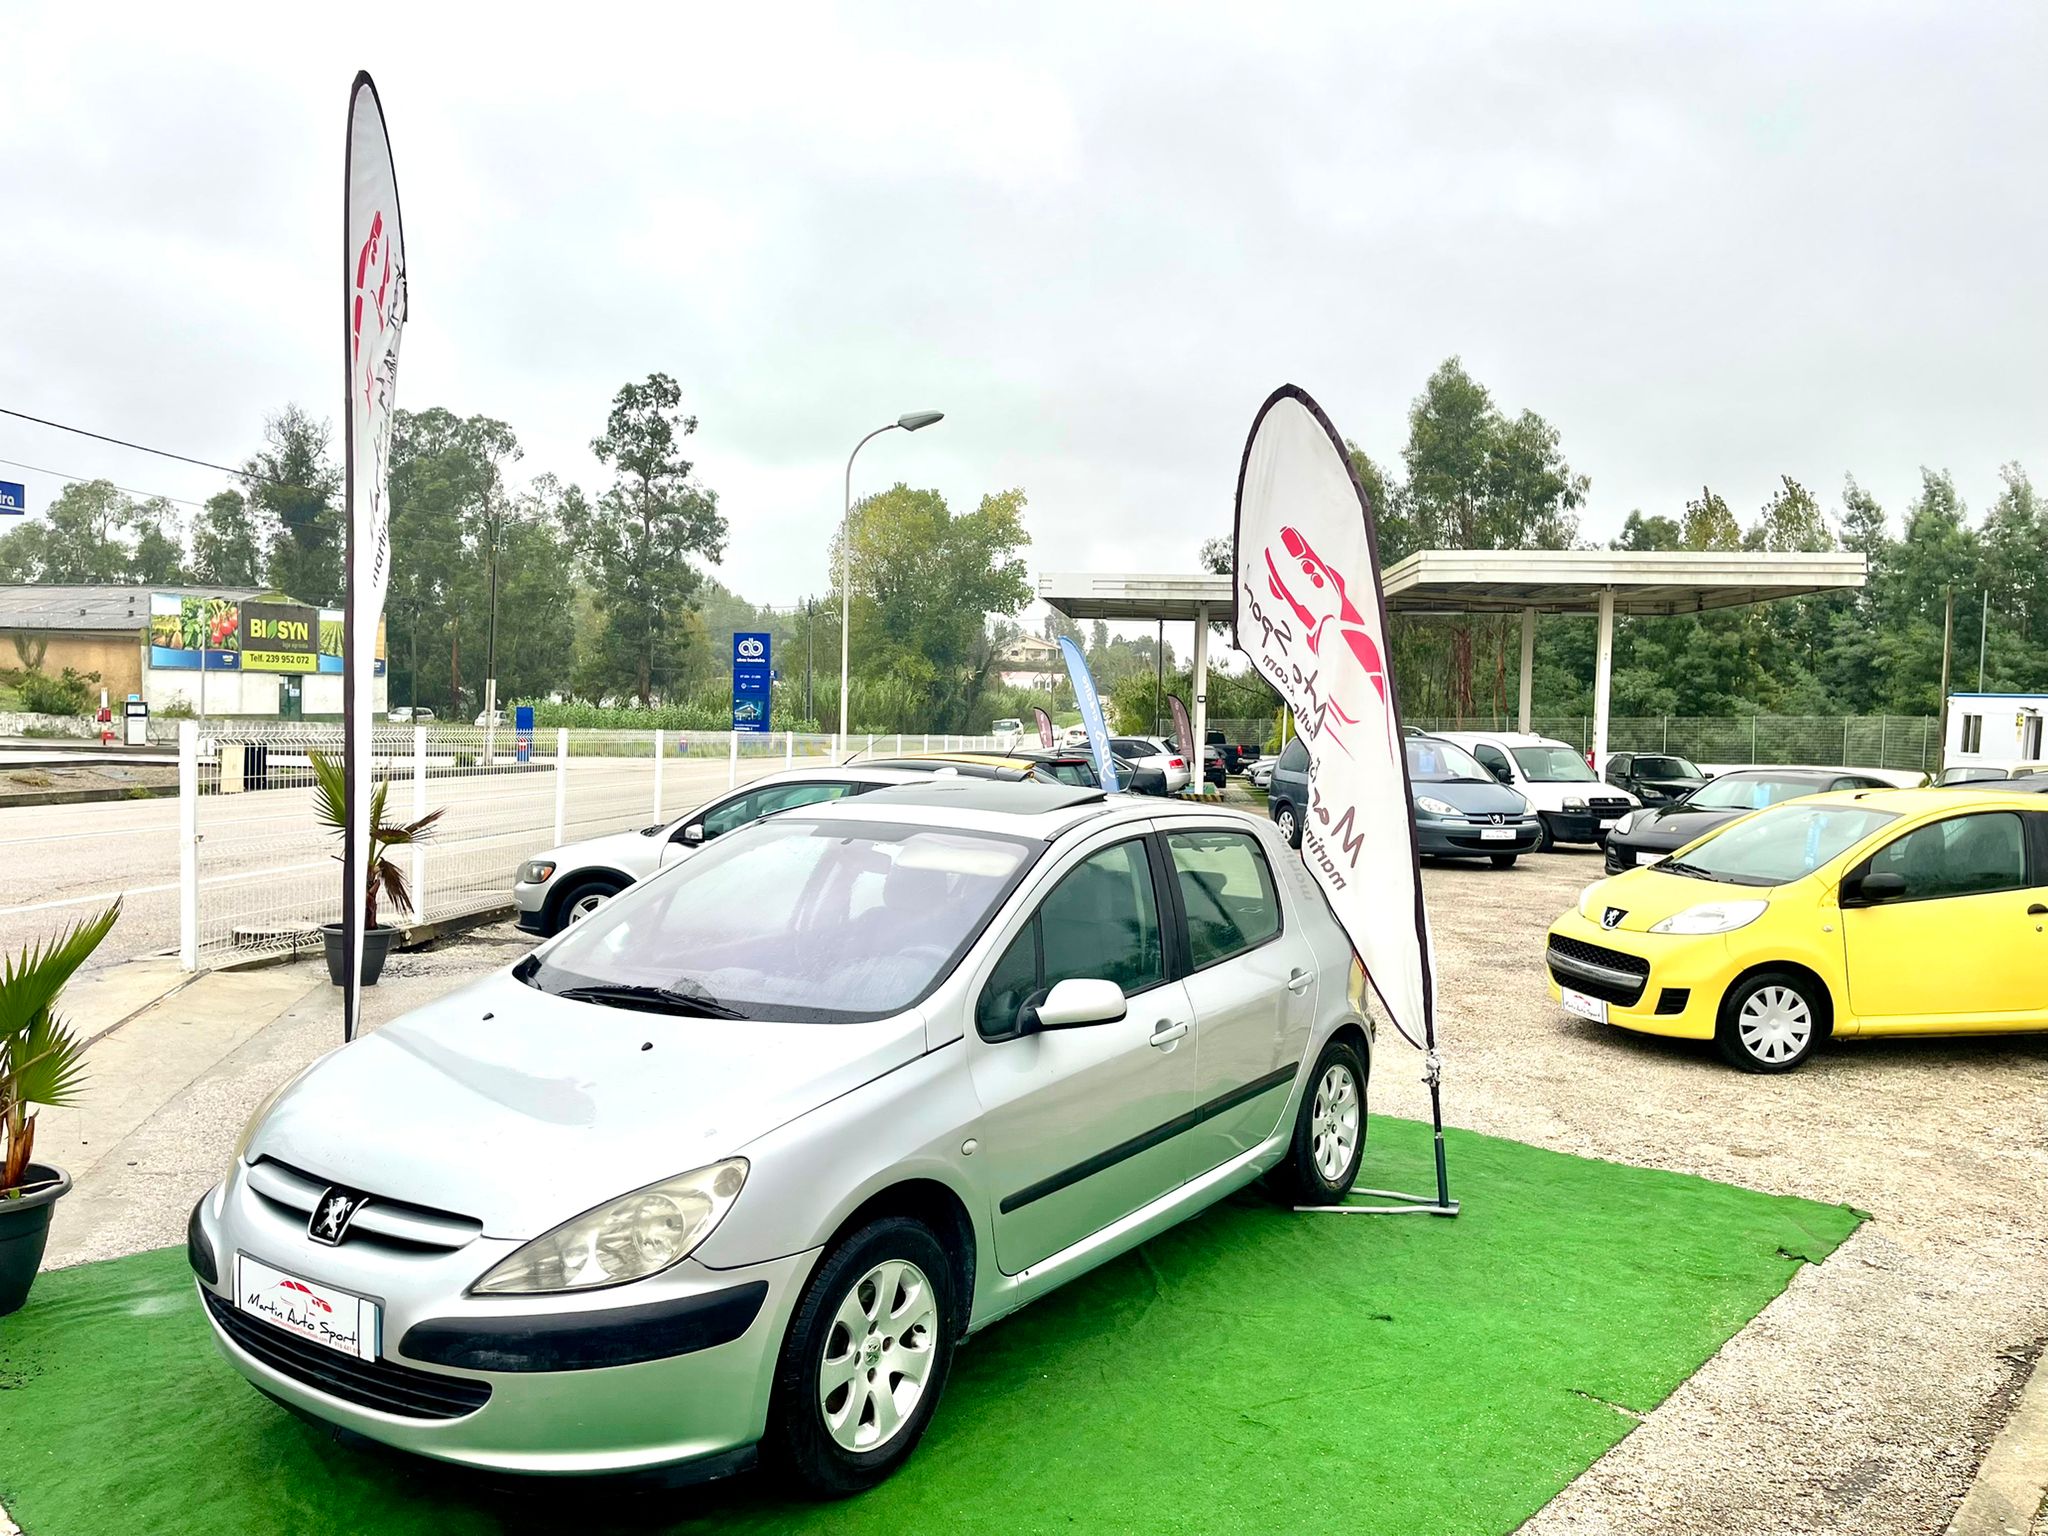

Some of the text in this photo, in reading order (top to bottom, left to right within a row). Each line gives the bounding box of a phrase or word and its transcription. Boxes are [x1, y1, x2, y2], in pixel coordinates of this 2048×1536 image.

[266, 654, 280, 663] 239
[281, 655, 295, 664] 952
[296, 656, 310, 665] 072
[247, 1293, 283, 1320] Martin
[287, 1308, 315, 1331] Auto
[319, 1321, 357, 1345] Sport
